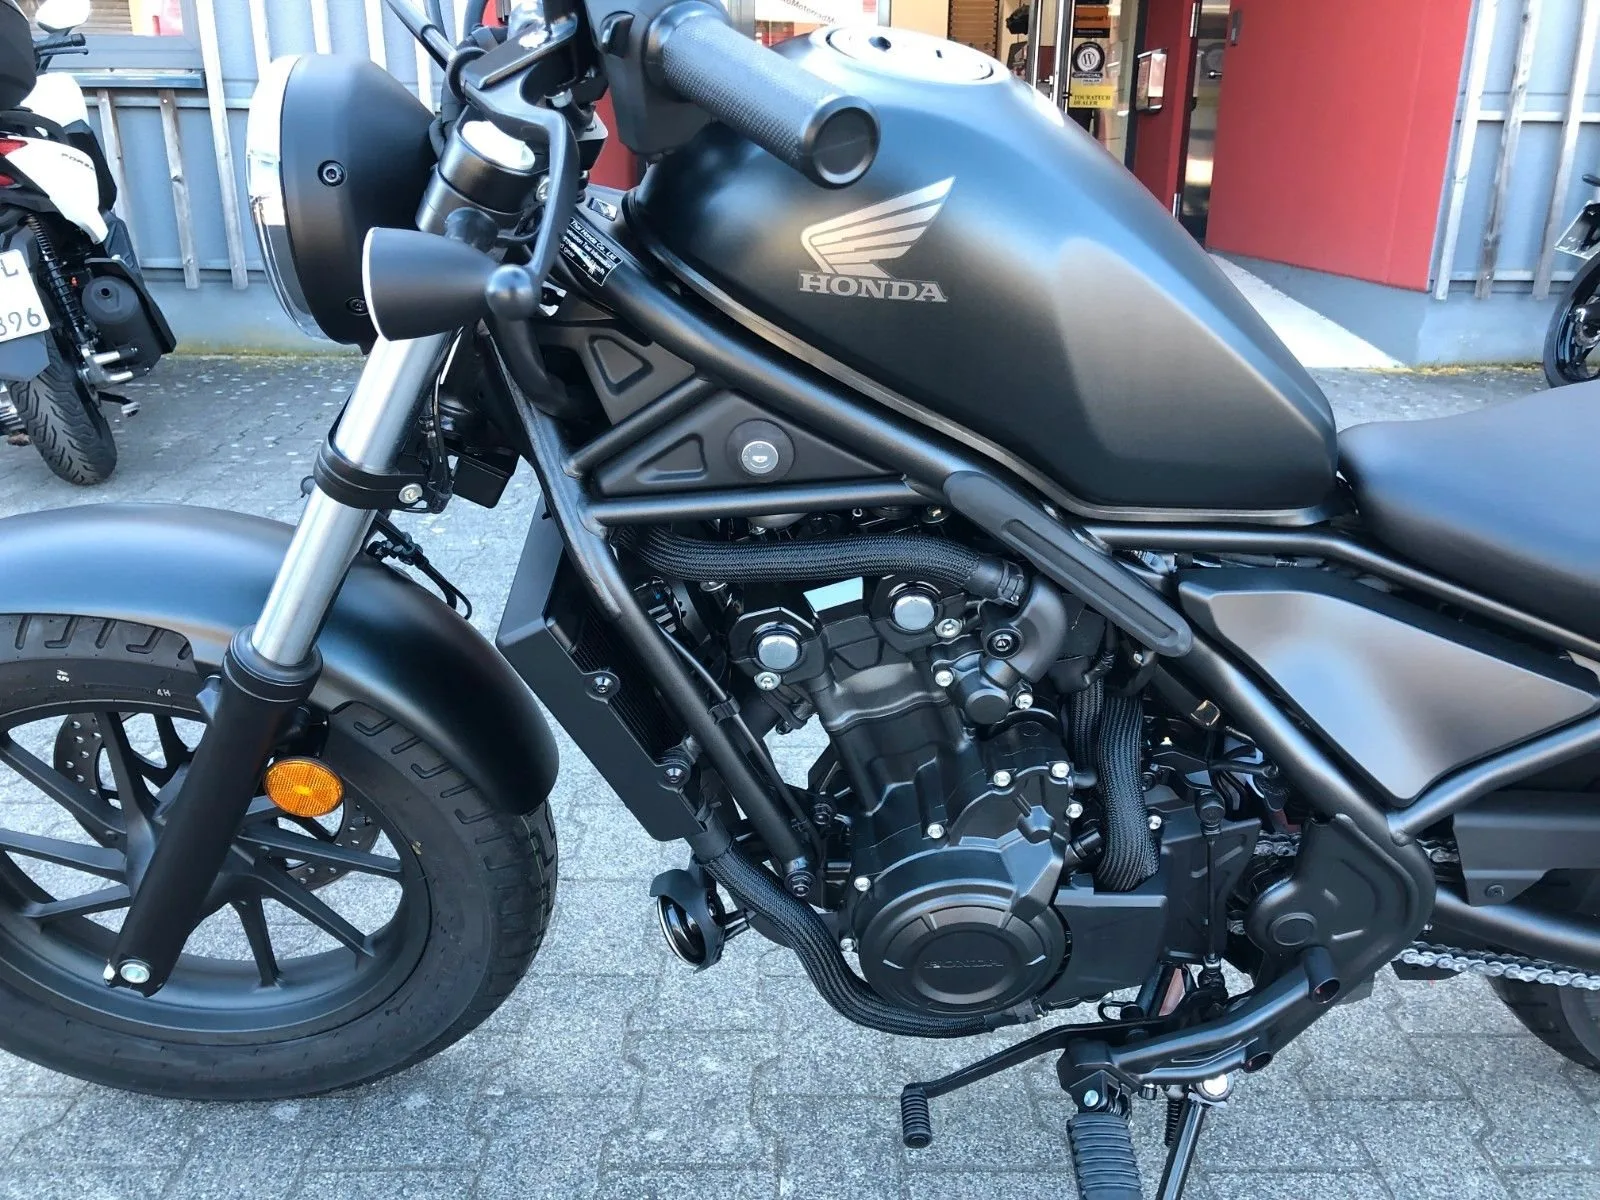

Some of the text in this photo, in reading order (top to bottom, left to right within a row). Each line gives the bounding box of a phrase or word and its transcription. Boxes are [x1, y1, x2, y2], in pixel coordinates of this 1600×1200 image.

[580, 229, 597, 244] Honda
[799, 273, 949, 303] HONDA
[924, 959, 1004, 969] HONDA
